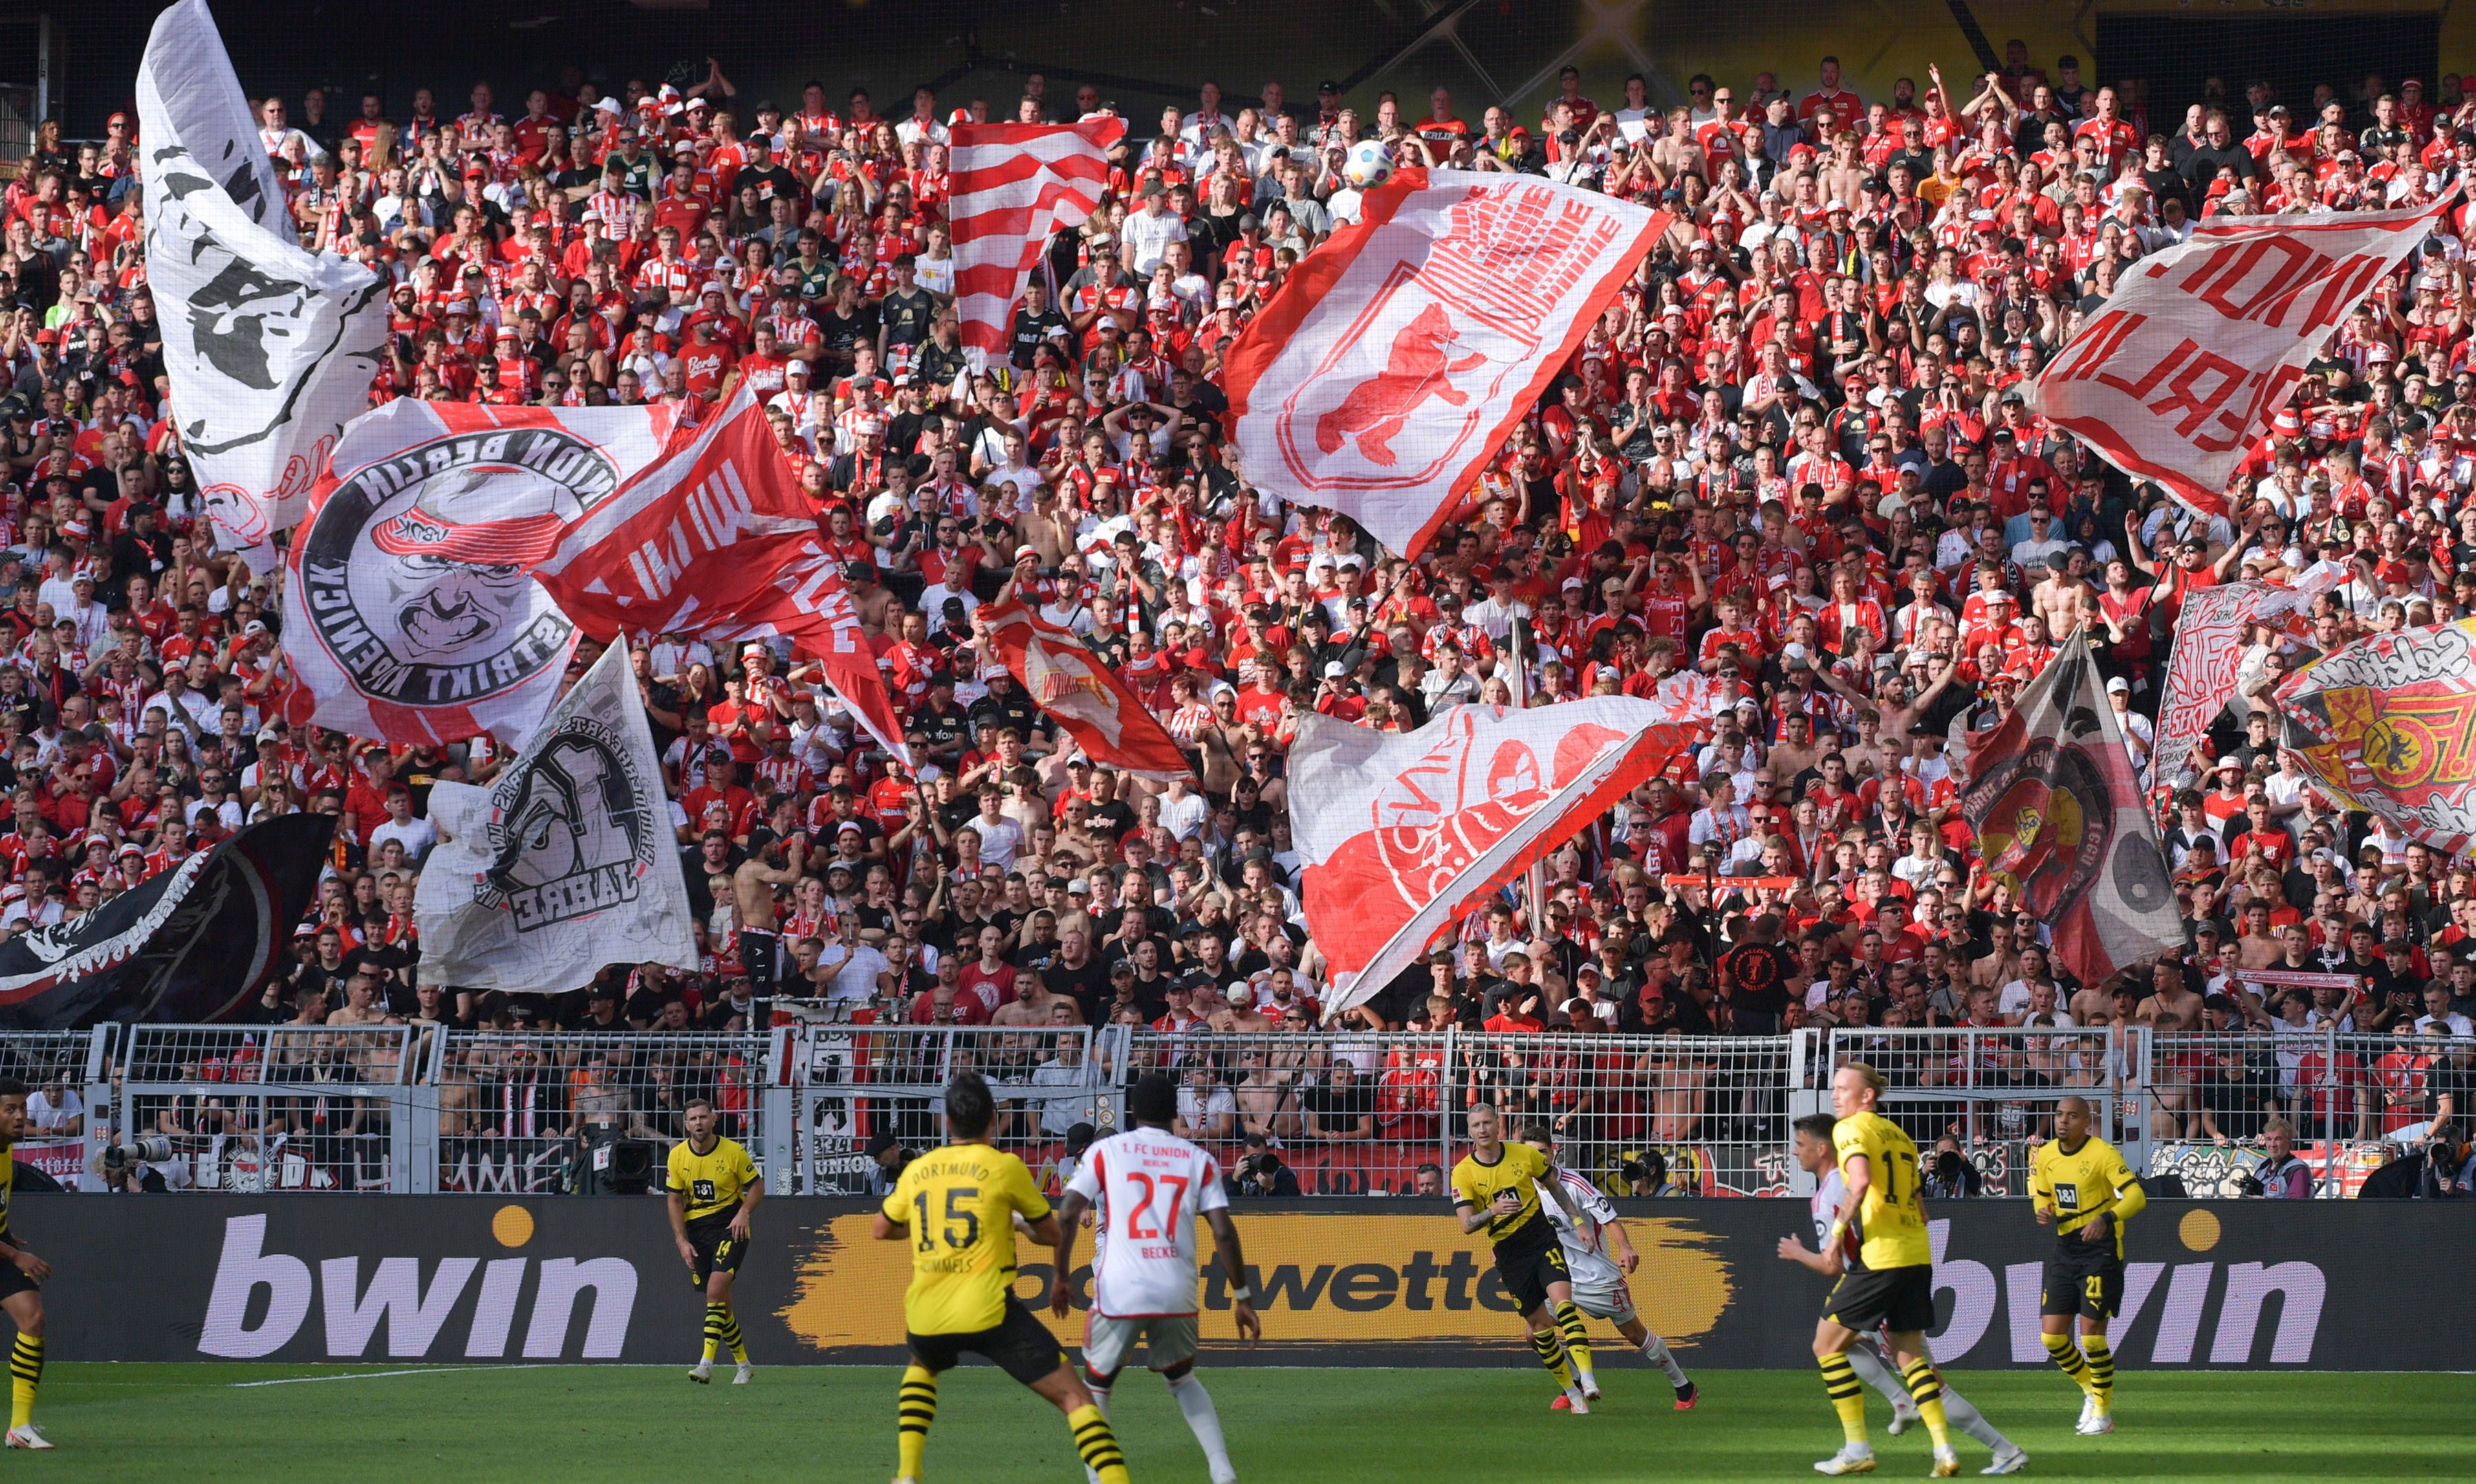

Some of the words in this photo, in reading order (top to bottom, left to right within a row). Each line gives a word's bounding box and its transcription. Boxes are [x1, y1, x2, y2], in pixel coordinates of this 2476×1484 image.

[688, 356, 721, 372] Berlin
[1123, 1144, 1131, 1154] 1.
[1135, 1144, 1149, 1156] FC
[1153, 1146, 1191, 1159] UNION
[1840, 1137, 1860, 1150] GLS
[1144, 1159, 1169, 1168] BERLIN
[913, 1161, 990, 1186] DORTMUND
[1882, 1150, 1915, 1210] 17
[695, 1181, 713, 1195] 1&1
[2057, 1190, 2076, 1205] 1&1
[1127, 1172, 1188, 1243] 27
[915, 1188, 978, 1253] 15
[716, 1240, 732, 1256] 14
[1141, 1246, 1178, 1259] BECKE
[1545, 1247, 1565, 1265] 11
[198, 1206, 637, 1358] bwin
[2085, 1275, 2103, 1298] 21
